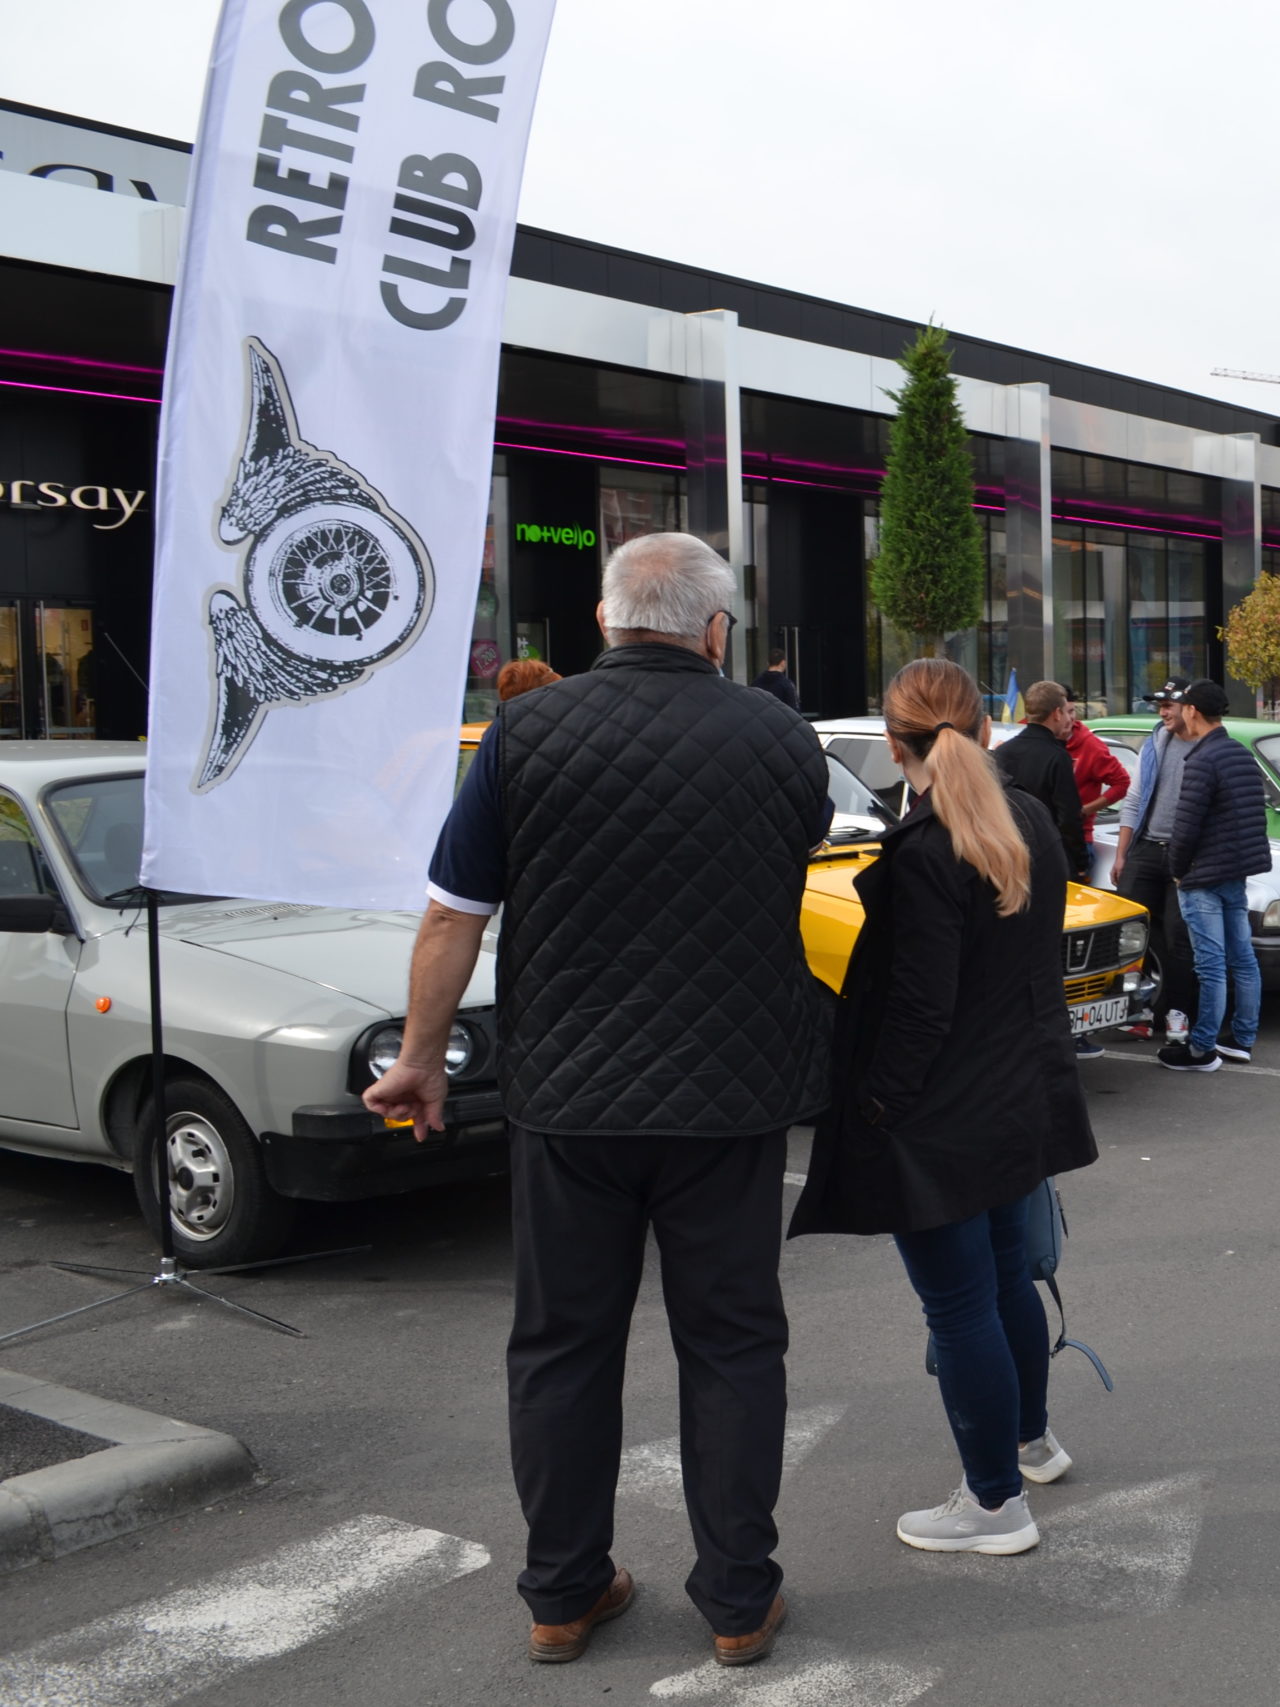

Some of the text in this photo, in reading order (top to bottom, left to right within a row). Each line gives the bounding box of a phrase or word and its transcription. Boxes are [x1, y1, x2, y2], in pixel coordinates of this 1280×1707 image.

[246, 0, 376, 265] RETRO
[380, 152, 483, 331] CLUB
[0, 480, 146, 530] rsay
